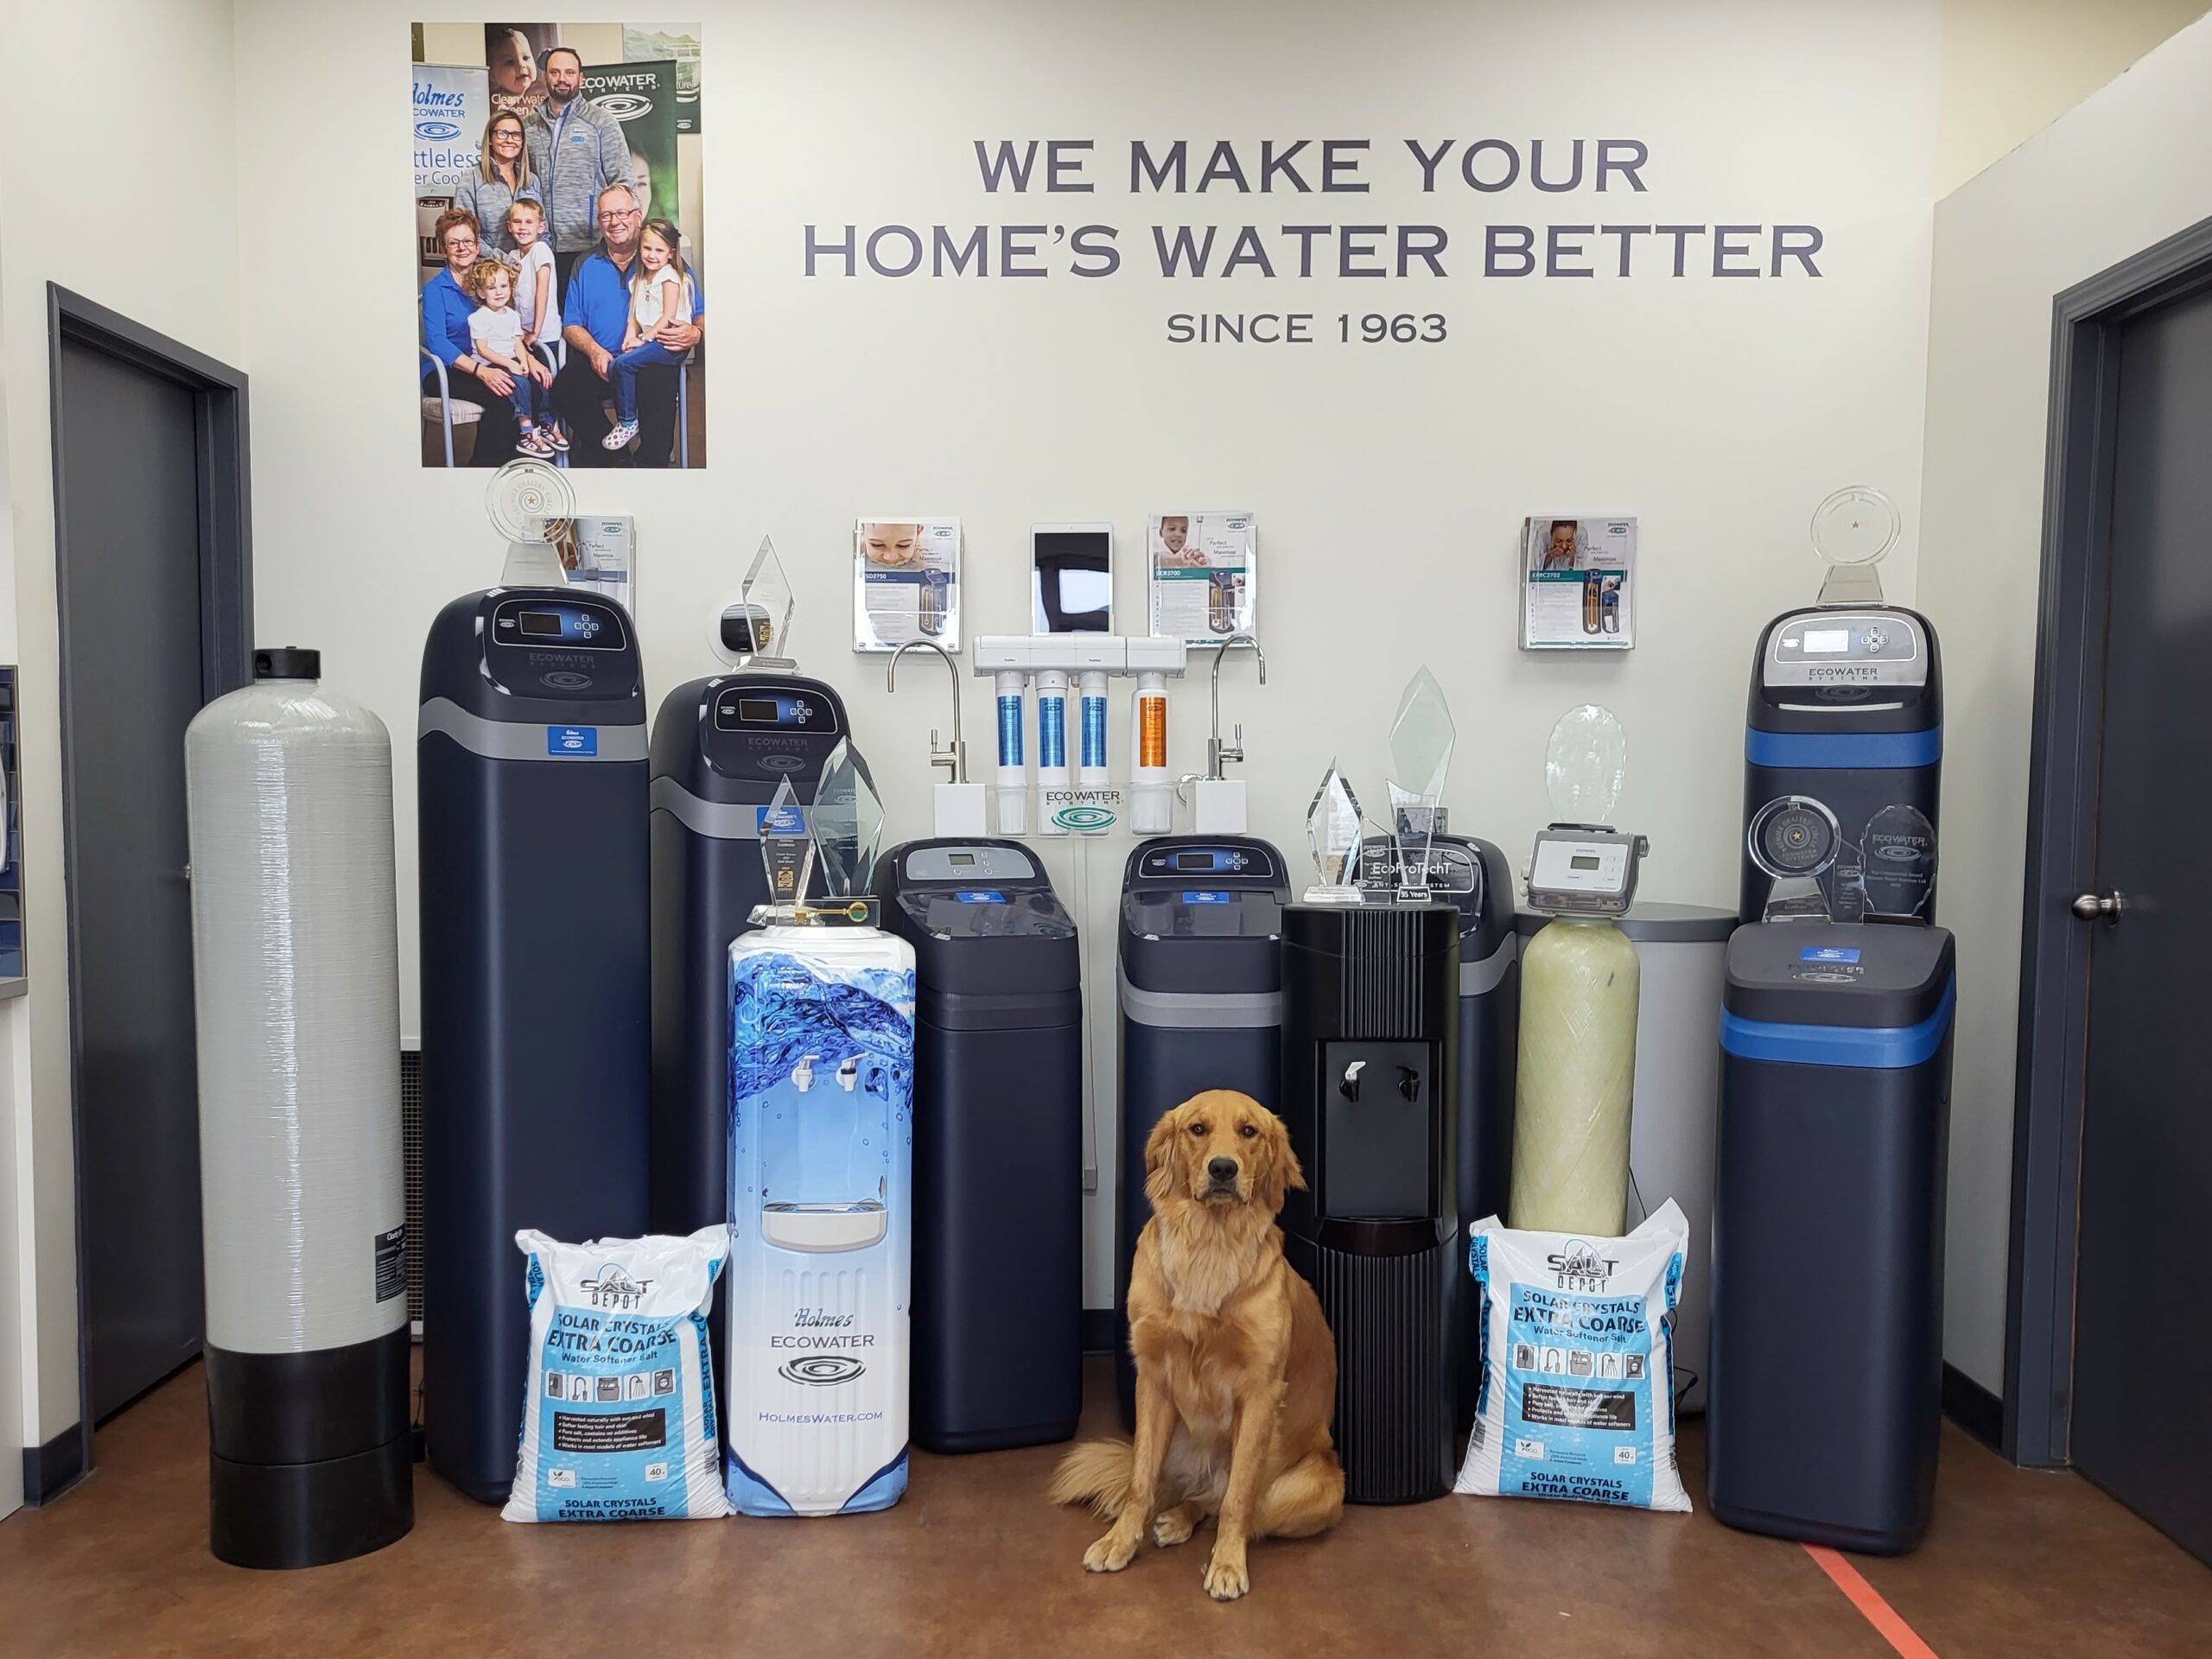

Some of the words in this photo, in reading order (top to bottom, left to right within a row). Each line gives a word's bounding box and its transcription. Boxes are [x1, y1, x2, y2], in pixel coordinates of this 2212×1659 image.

[579, 73, 657, 89] ECOWATER
[973, 139, 1095, 194] WE
[1129, 139, 1370, 194] MAKE
[1404, 139, 1649, 194] YOUR
[803, 225, 1122, 279] HOME'S
[1152, 225, 1447, 279] WATER
[1483, 225, 1825, 279] BETTER
[1166, 313, 1314, 344] SINCE
[1337, 313, 1449, 344] 1963
[530, 652, 594, 663] ECOWATER
[747, 737, 808, 747] ECOWATER
[1046, 791, 1120, 801] ECOWATER
[1468, 1236, 1480, 1279] CRYSTALS
[1479, 1243, 1488, 1271] SOLAR
[1548, 1254, 1619, 1277] SALT
[1557, 1274, 1607, 1293] DEPOT
[592, 1293, 641, 1309] DEPOT
[1523, 1290, 1568, 1310] SOLAR
[1573, 1301, 1641, 1313] CRYSTALS
[558, 1313, 600, 1332] SOLAR
[794, 1307, 855, 1328] Holmes
[1514, 1306, 1573, 1327] EXTRA
[1579, 1316, 1646, 1333] COARSE
[547, 1330, 601, 1352] EXTRA
[607, 1330, 677, 1354] COARSE
[770, 1334, 874, 1349] ECOWATER
[1566, 1329, 1609, 1343] Softener
[1611, 1332, 1626, 1343] Salt
[562, 1352, 589, 1363] Water
[639, 1351, 658, 1361] Salt
[699, 1336, 711, 1390] EXTRA
[650, 1467, 662, 1476] 40
[1530, 1471, 1566, 1483] SOLAR
[1569, 1476, 1623, 1488] CRYSTALS
[1522, 1482, 1567, 1493] EXTRA
[1573, 1486, 1630, 1501] COARSE
[565, 1499, 601, 1508] SOLAR
[603, 1497, 657, 1508] CRYSTALS
[558, 1509, 605, 1518] EXTRA
[608, 1507, 665, 1517] COARSE
